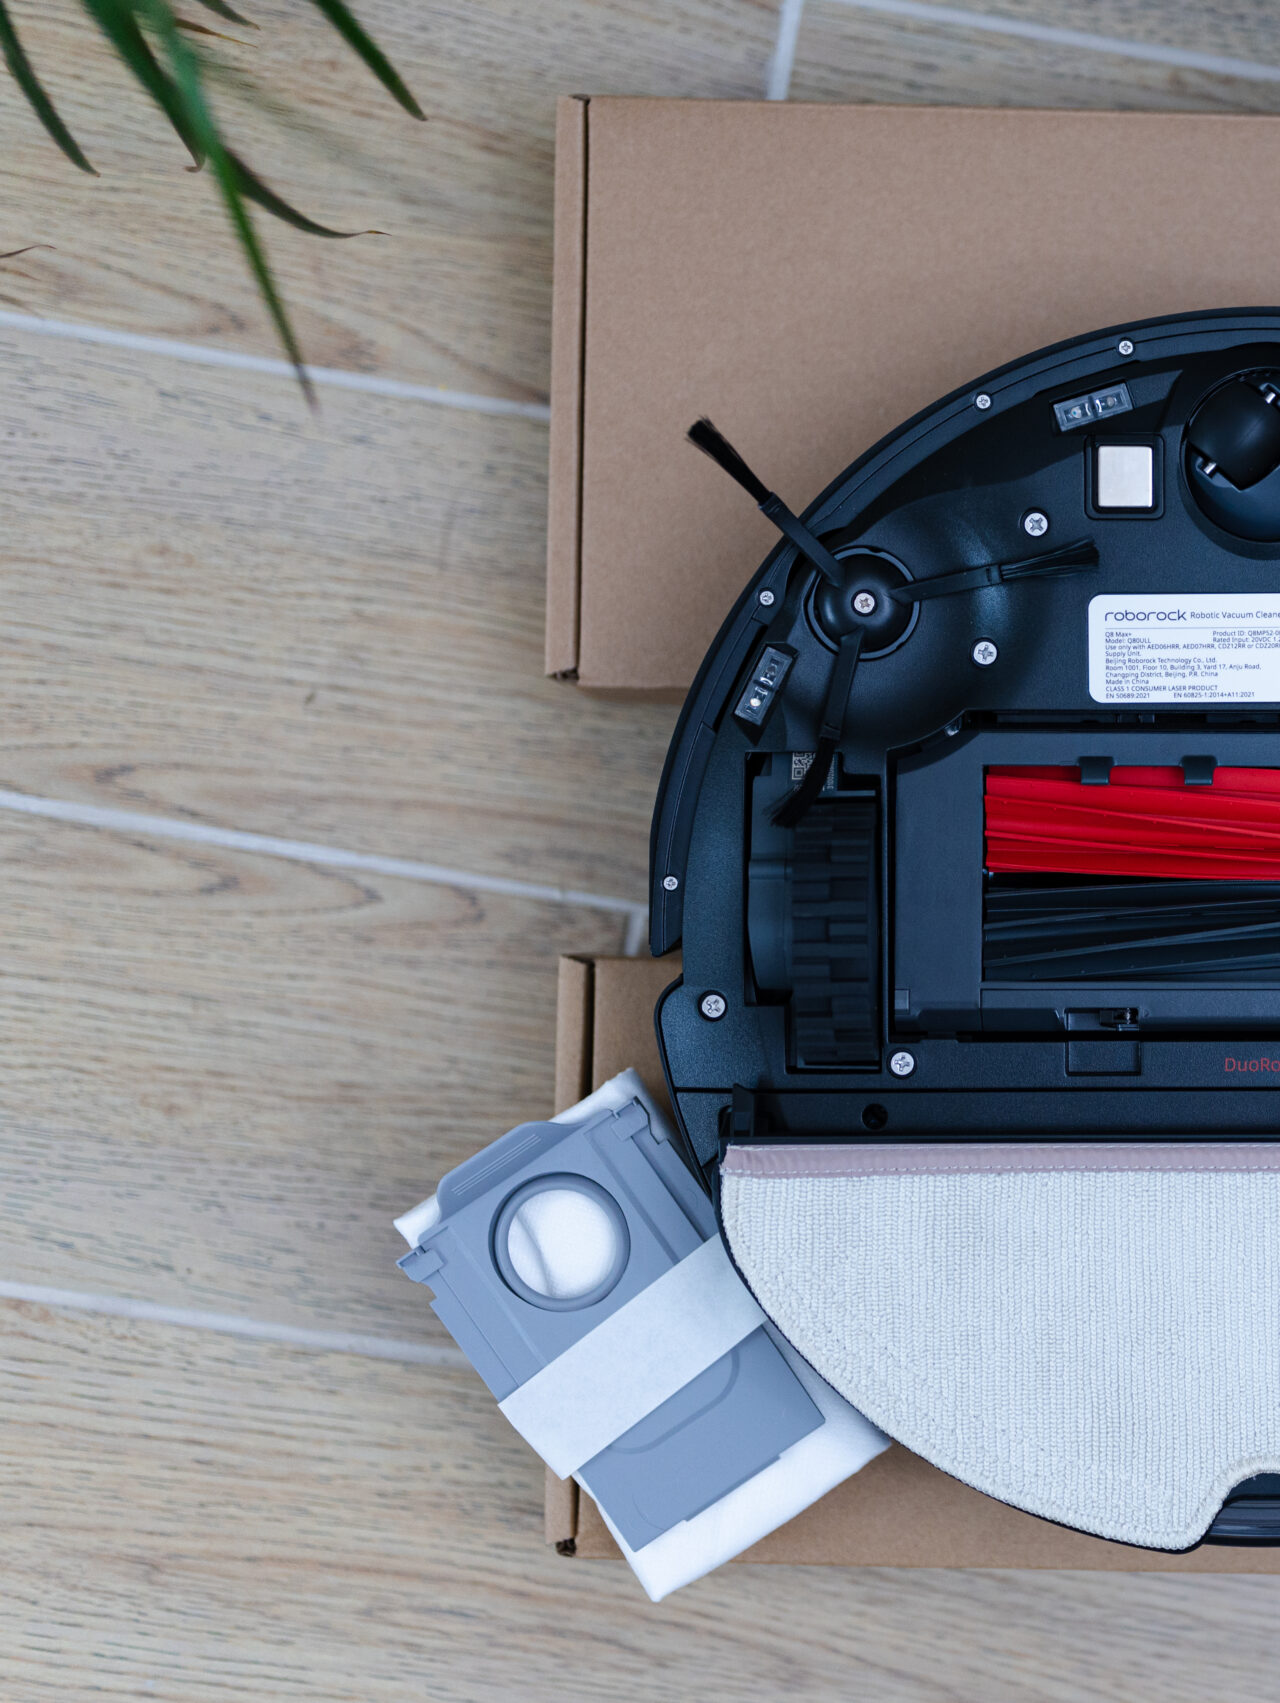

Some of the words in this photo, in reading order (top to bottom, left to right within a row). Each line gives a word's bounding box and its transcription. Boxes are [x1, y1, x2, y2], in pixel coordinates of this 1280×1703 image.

[1105, 609, 1187, 621] roborock
[1190, 611, 1220, 619] Robotic
[1222, 611, 1253, 619] Vacuum
